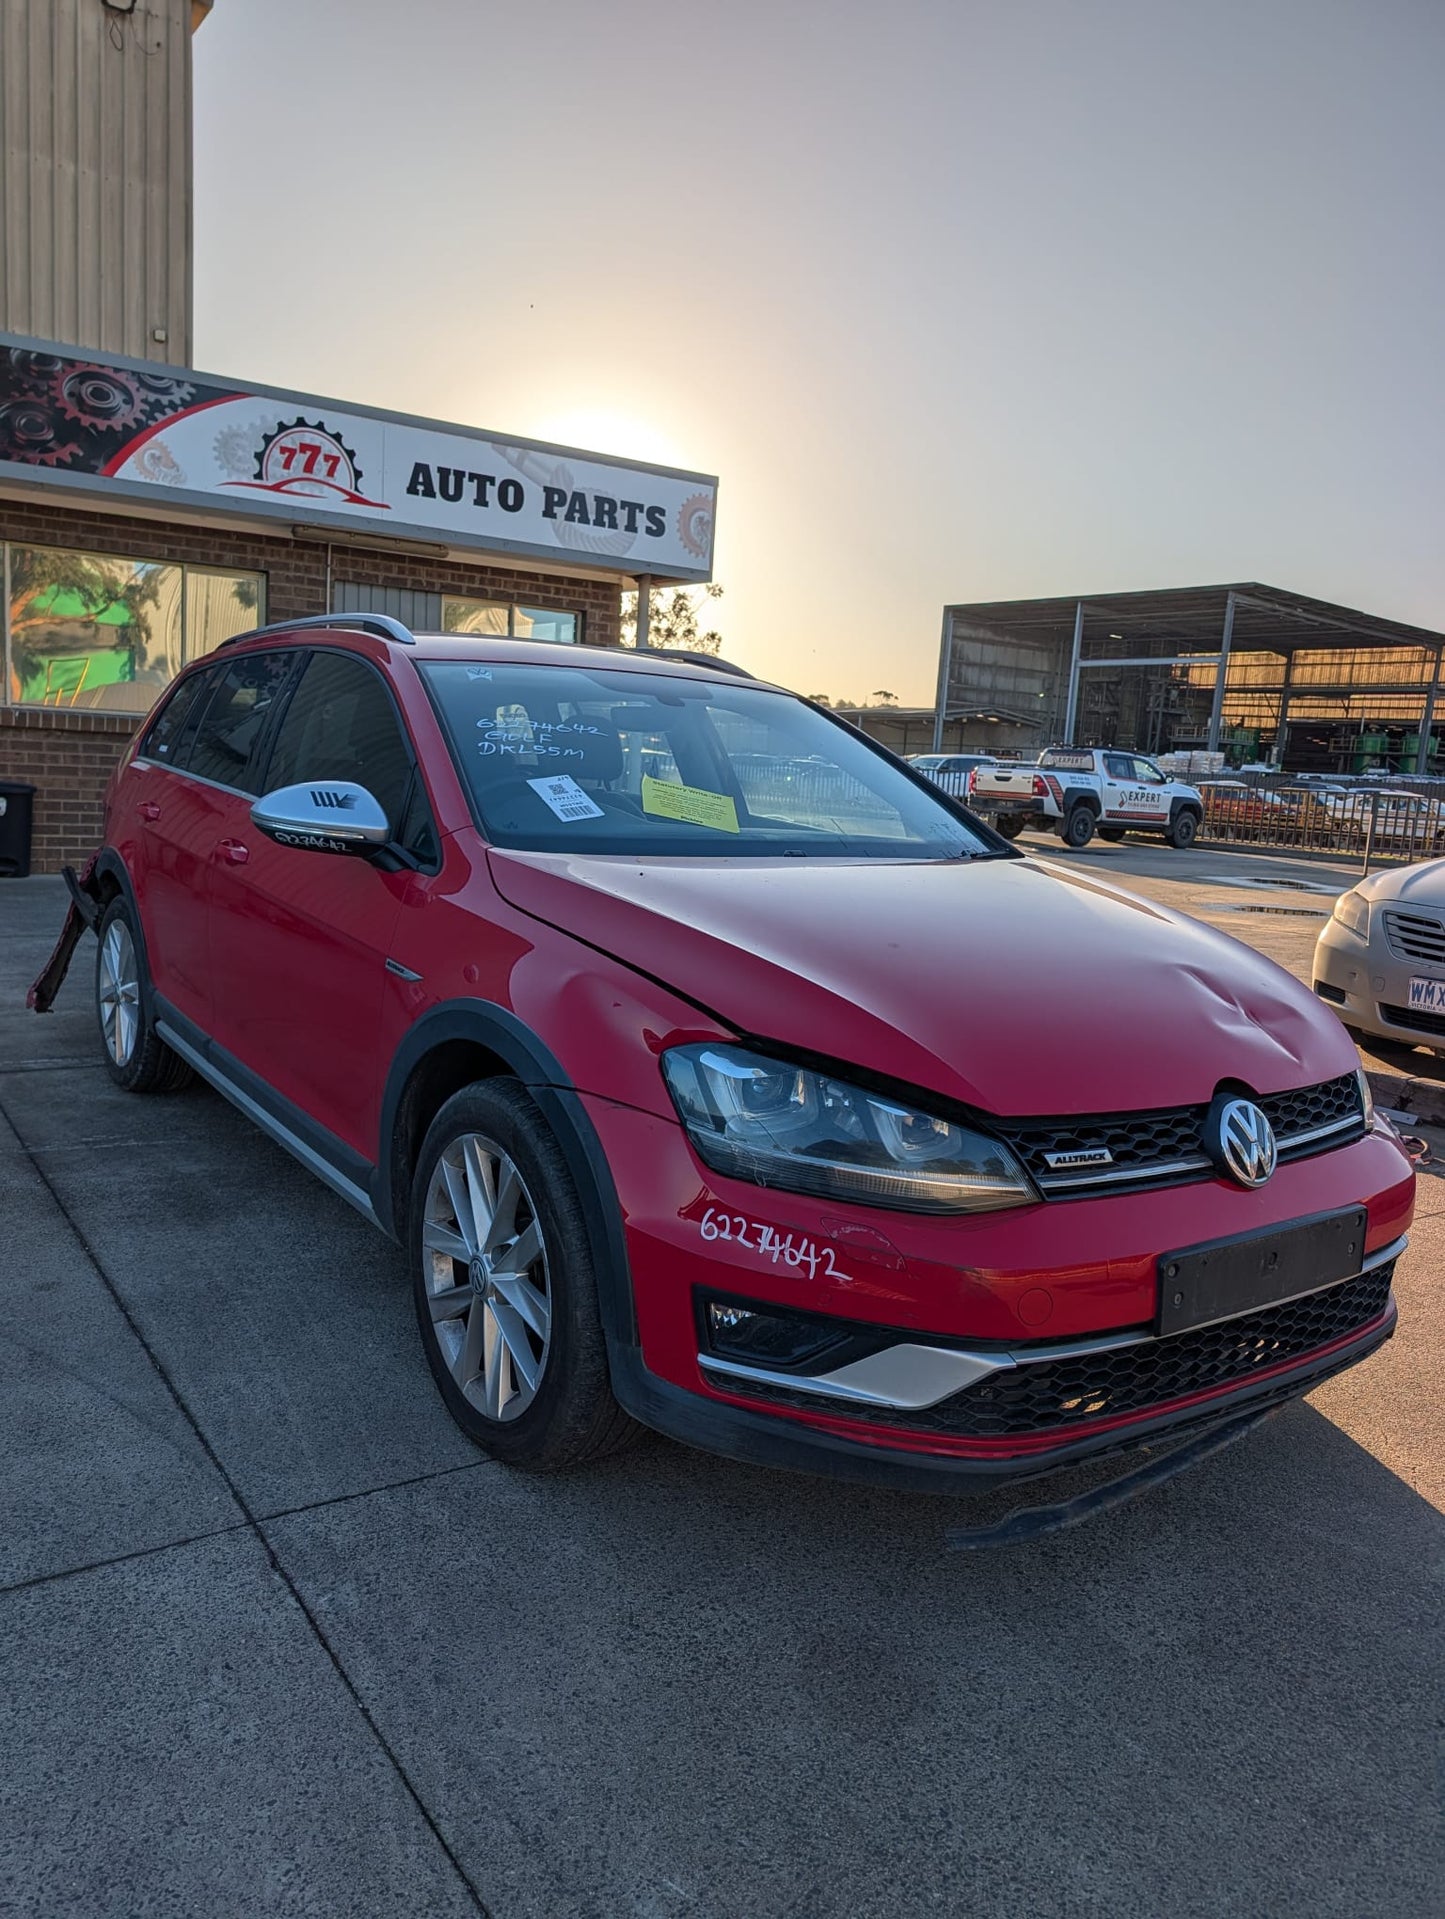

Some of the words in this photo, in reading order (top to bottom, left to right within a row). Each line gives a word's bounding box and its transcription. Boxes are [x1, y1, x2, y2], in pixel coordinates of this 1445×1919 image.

[279, 442, 341, 478] 777
[406, 462, 525, 513] AUTO
[542, 485, 667, 538] PARTS
[1128, 791, 1161, 803] EXPERT
[1411, 982, 1445, 1006] WMX
[1054, 1152, 1107, 1165] ALLTRACK
[700, 1208, 854, 1281] 62274642
